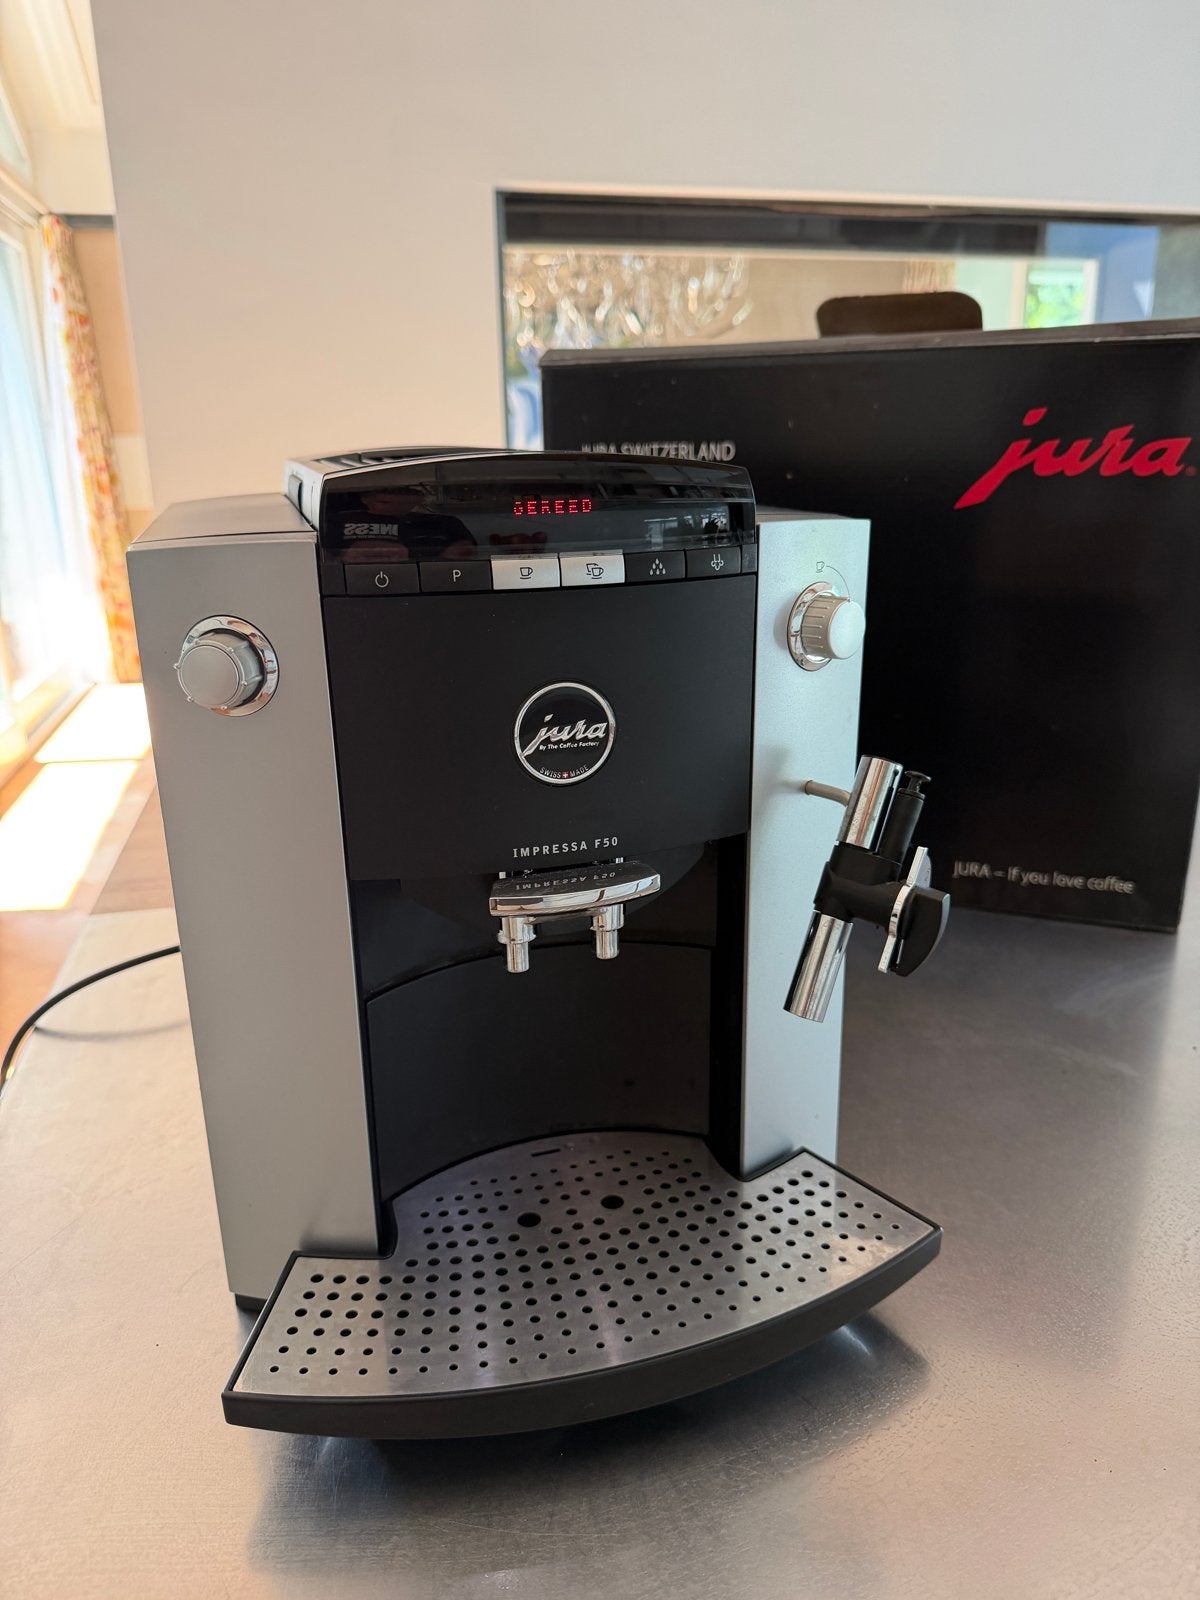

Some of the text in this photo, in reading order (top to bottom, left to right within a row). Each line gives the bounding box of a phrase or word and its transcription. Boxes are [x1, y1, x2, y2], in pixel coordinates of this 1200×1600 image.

[620, 440, 736, 462] SWITZERLAND
[953, 407, 1192, 510] jura
[513, 499, 592, 515] GEREED
[452, 569, 462, 582] P
[521, 713, 608, 758] jura
[540, 764, 589, 778] SWISS MADE
[513, 836, 619, 858] IMPRESSA F50
[952, 861, 992, 879] JURA
[1021, 871, 1050, 887] you
[1053, 871, 1086, 889] love
[1087, 875, 1136, 894] coffee
